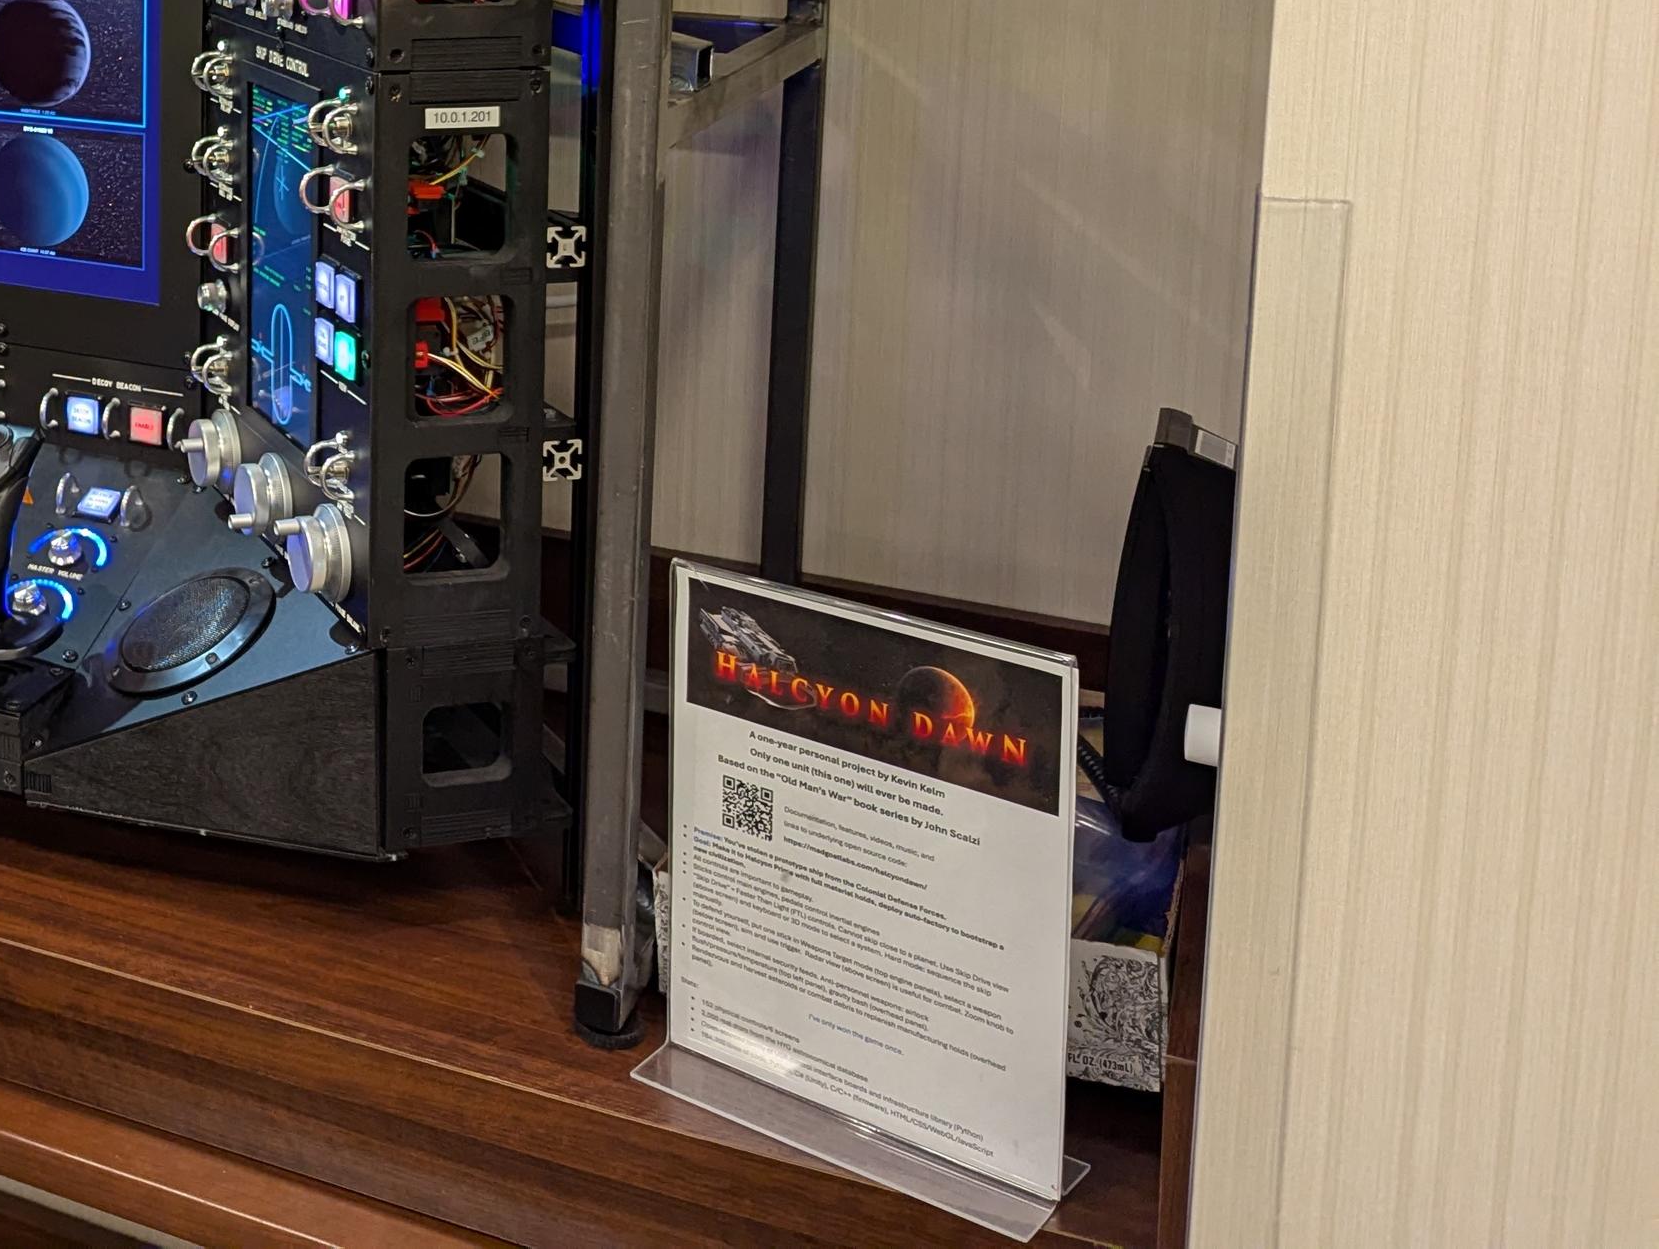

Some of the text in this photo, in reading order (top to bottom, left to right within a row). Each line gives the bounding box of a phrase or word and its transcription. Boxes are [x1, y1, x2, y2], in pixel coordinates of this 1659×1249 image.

[285, 56, 309, 77] CONTROL
[433, 110, 491, 124] 10.0.1.201
[91, 377, 141, 392] DECOY BEACON
[27, 563, 84, 581] MASTER VOLUME
[714, 648, 1028, 766] HALCYON DAWN
[749, 730, 944, 798] A one-year personal project by Kevin Kelm
[750, 747, 943, 815] Only one unit (this one) will ever be made.
[718, 754, 744, 769] Based
[747, 765, 757, 773] on
[760, 768, 774, 779] the
[854, 798, 877, 812] book
[879, 806, 908, 822] series
[911, 816, 922, 828] by
[925, 821, 946, 834] John
[950, 828, 979, 845] Scalzi
[747, 845, 767, 857] stolen
[774, 854, 807, 872] prototype
[809, 866, 823, 877] ship
[825, 872, 840, 883] from
[842, 878, 853, 888] the
[856, 883, 885, 899] Colonial
[888, 894, 917, 910] Defense
[919, 905, 946, 920] Forces.
[1100, 1058, 1133, 1073] (473mL)
